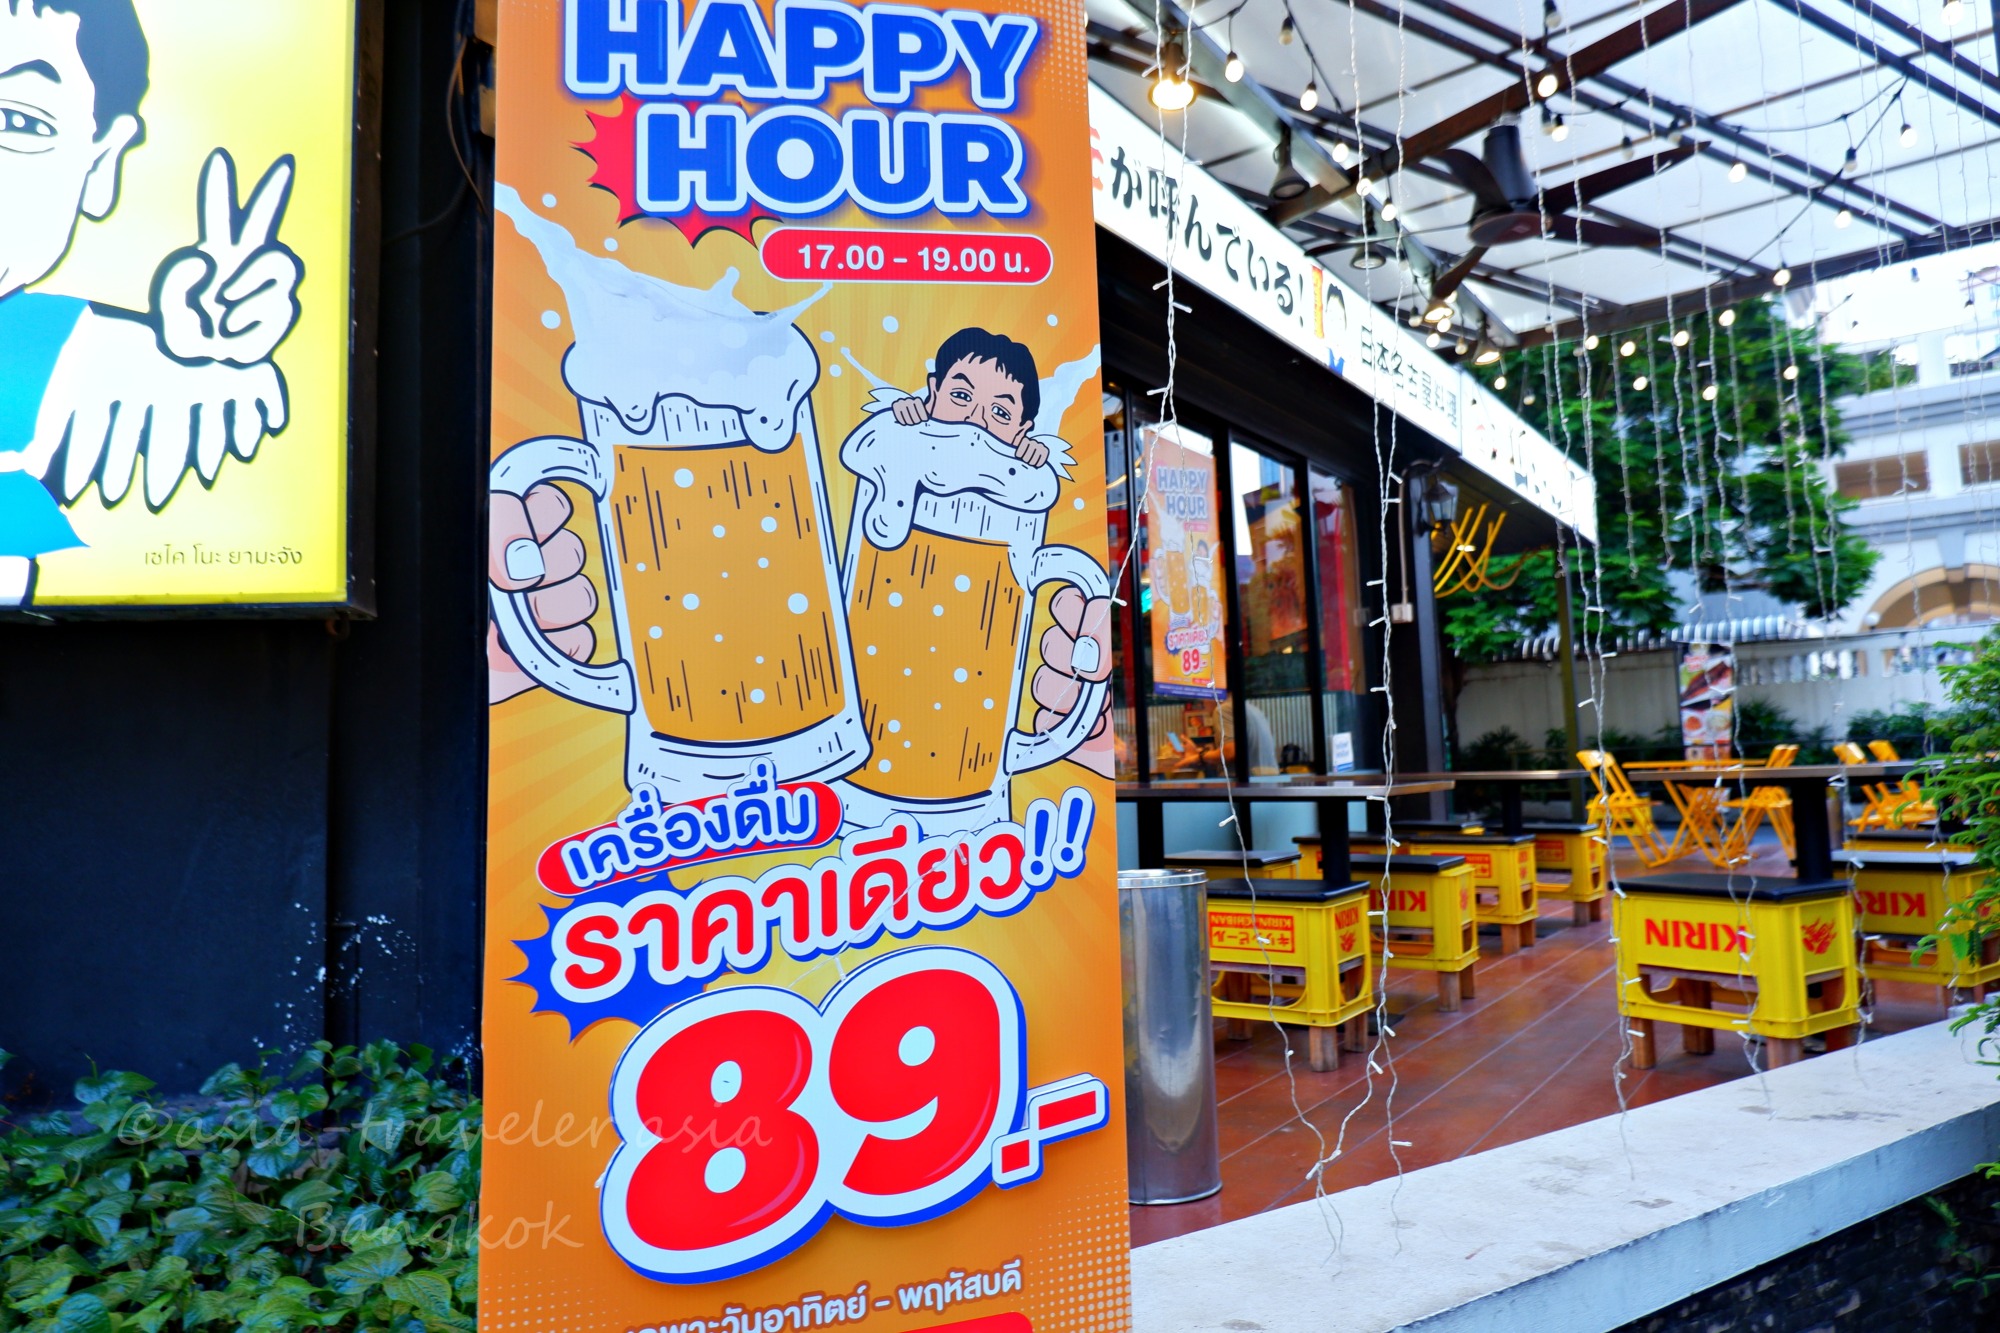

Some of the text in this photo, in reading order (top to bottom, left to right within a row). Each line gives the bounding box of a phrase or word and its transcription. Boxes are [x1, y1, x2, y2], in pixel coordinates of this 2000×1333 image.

[571, 0, 1033, 106] HAPPY
[640, 106, 1023, 211] HOUR
[798, 244, 885, 271] 17.00
[917, 247, 996, 272] 19.00
[1004, 251, 1031, 273] น.
[1157, 467, 1207, 493] HAPPY
[1166, 494, 1207, 518] HOUR
[192, 542, 221, 565] โนะ
[229, 546, 303, 565] ยามะจัง
[564, 759, 815, 887] เครื่องดื่ม
[1369, 889, 1427, 912] KIRI
[1854, 890, 1926, 917] KIRI
[1211, 914, 1292, 928] KIRIN CHIBAN
[1334, 905, 1360, 931] KIRIN
[1644, 917, 1748, 954] KIRIN
[627, 1284, 868, 1333] ะวันอาทิตย์
[898, 1258, 1022, 1311] พฤหัสบดี
